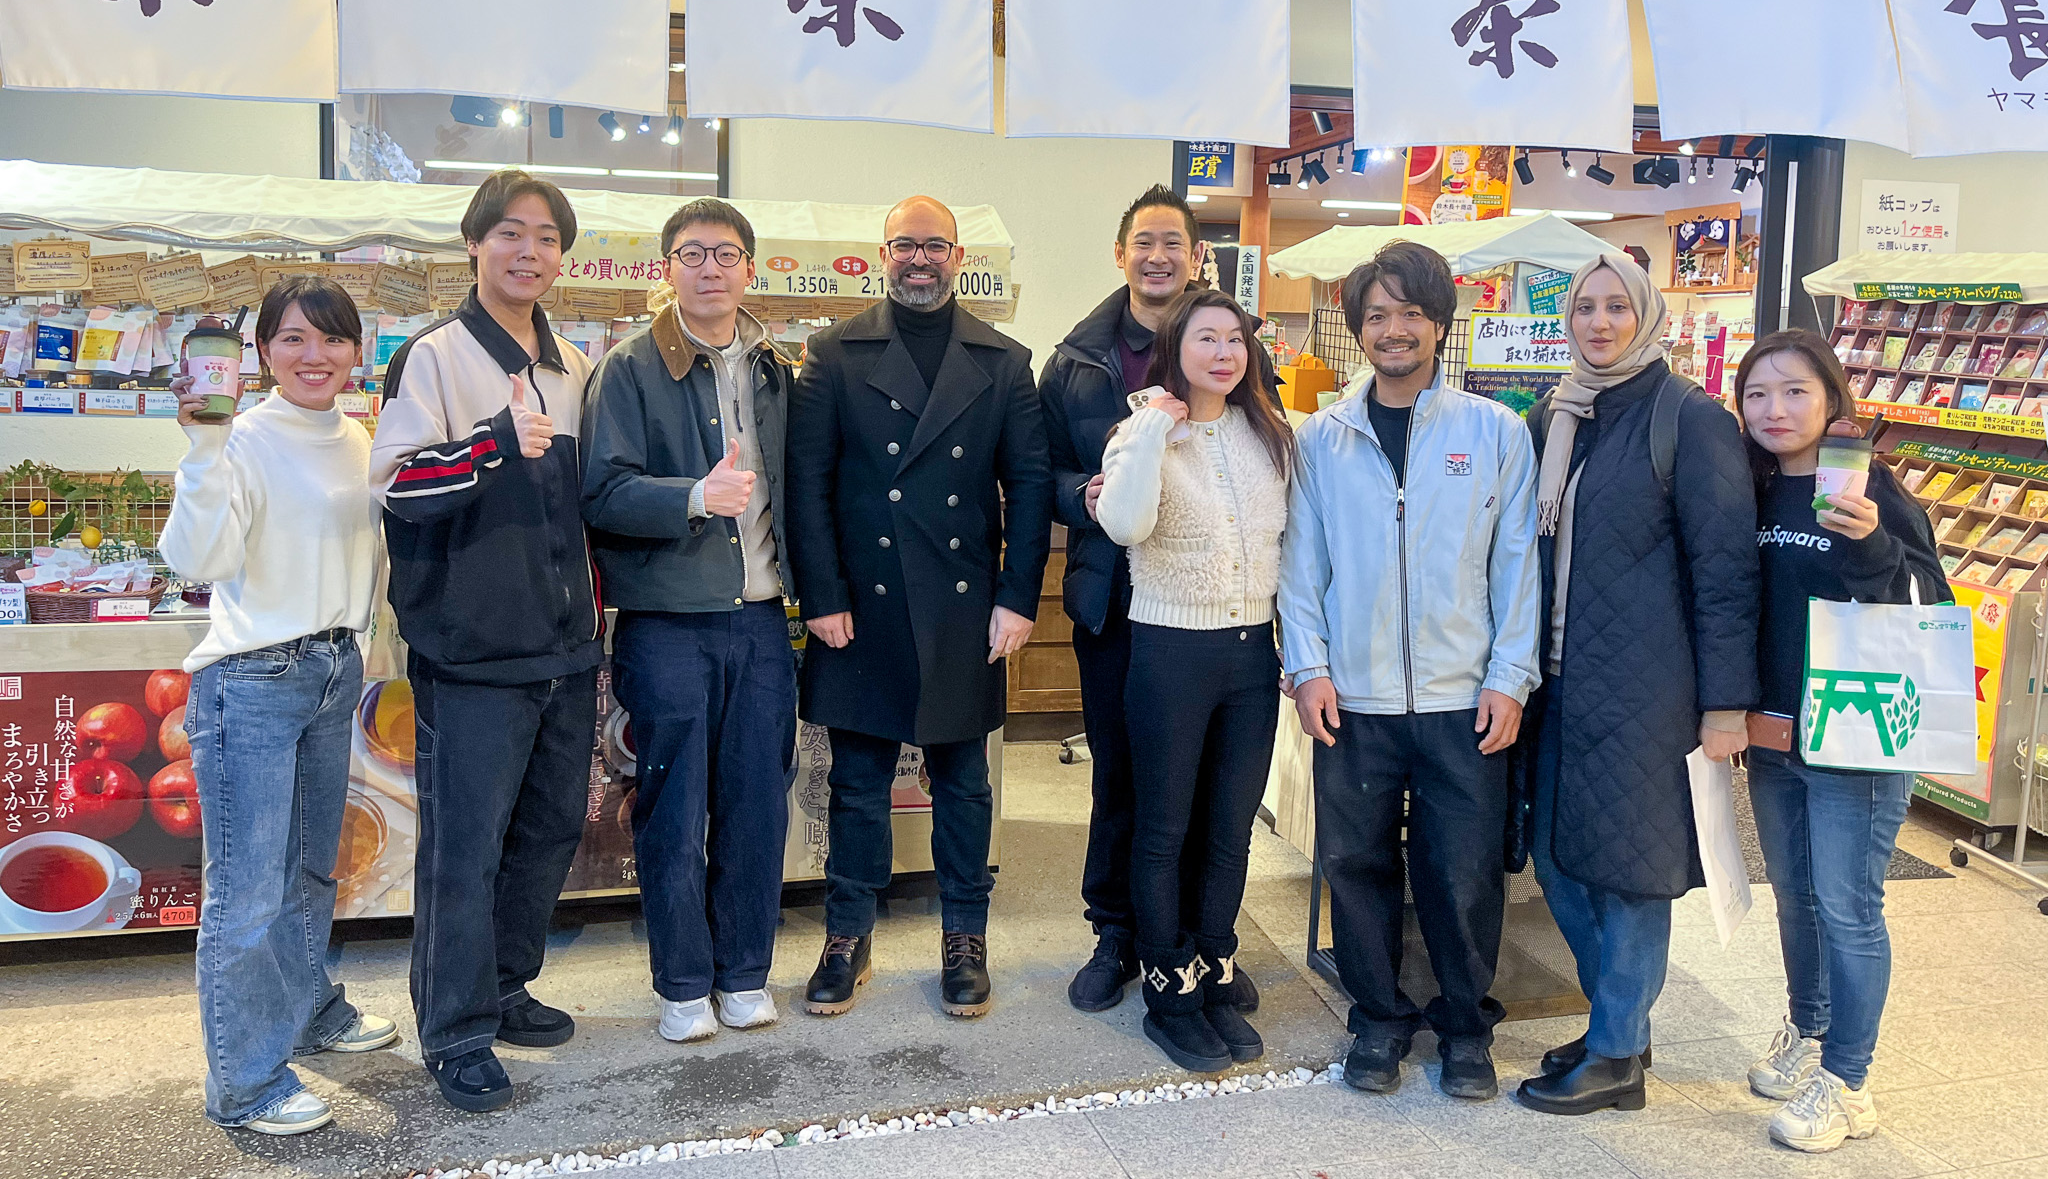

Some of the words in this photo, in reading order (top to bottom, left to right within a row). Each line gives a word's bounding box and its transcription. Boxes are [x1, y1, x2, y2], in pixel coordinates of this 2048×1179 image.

[1987, 87, 2048, 111] ヤマ
[1189, 144, 1227, 153] 木長十商店
[1879, 194, 1940, 213] 紙コップは
[1877, 241, 1932, 253] お願いします。
[786, 275, 838, 294] 1,350円
[1917, 285, 2001, 299] メッセージティーバッグ
[1478, 317, 1567, 340] 店内にて抹茶
[1467, 374, 1508, 383] Captivating
[1509, 375, 1520, 383] the
[1522, 375, 1541, 383] World
[1756, 524, 1832, 552] ipSquare
[50, 694, 77, 819] 自然な甘さが
[1, 722, 26, 833] まろやかさ
[24, 742, 50, 824] 引き立つ
[1924, 783, 1949, 798] Featured
[1950, 793, 1977, 809] Products
[130, 892, 197, 909] 蜜りんご
